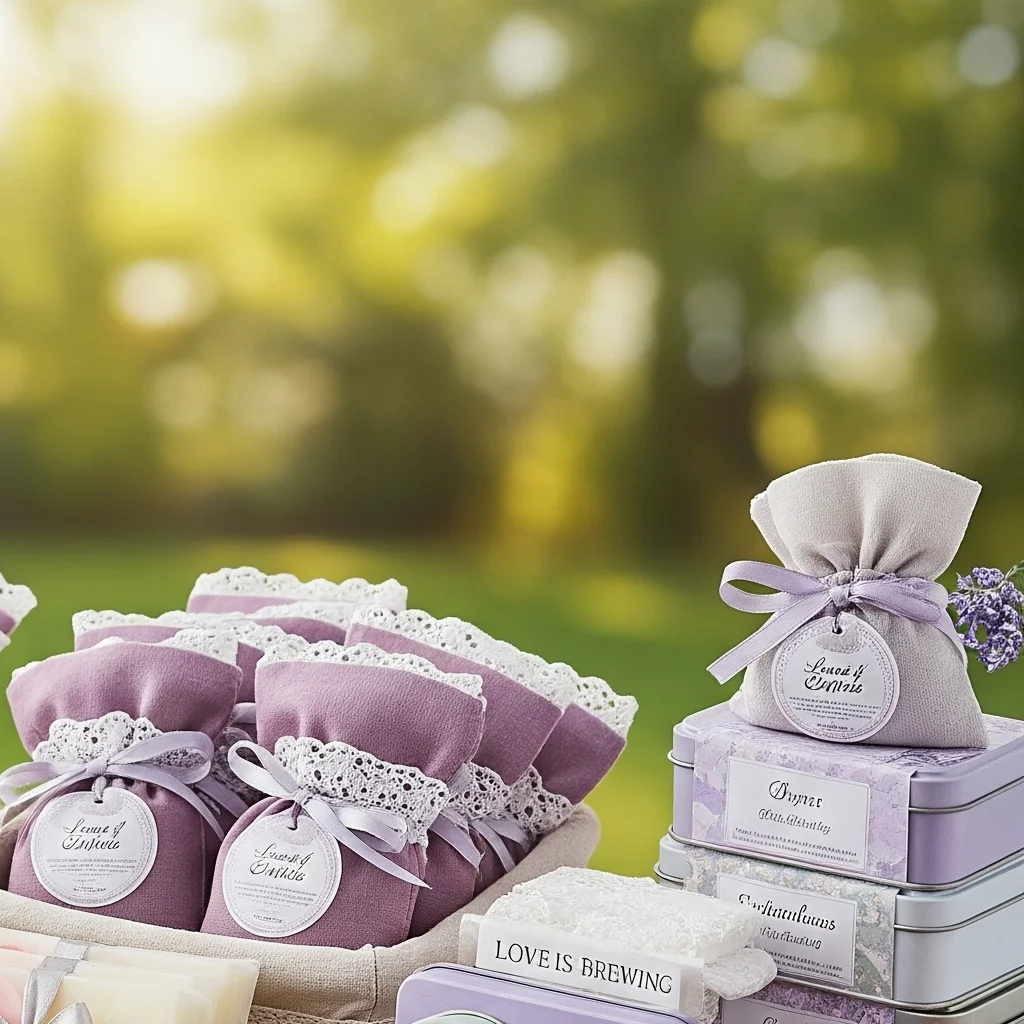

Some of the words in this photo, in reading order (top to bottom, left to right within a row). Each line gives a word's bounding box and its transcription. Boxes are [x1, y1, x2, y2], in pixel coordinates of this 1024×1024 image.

[494, 940, 551, 970] LOVE
[554, 952, 574, 974] IS
[580, 957, 674, 995] BREWING
